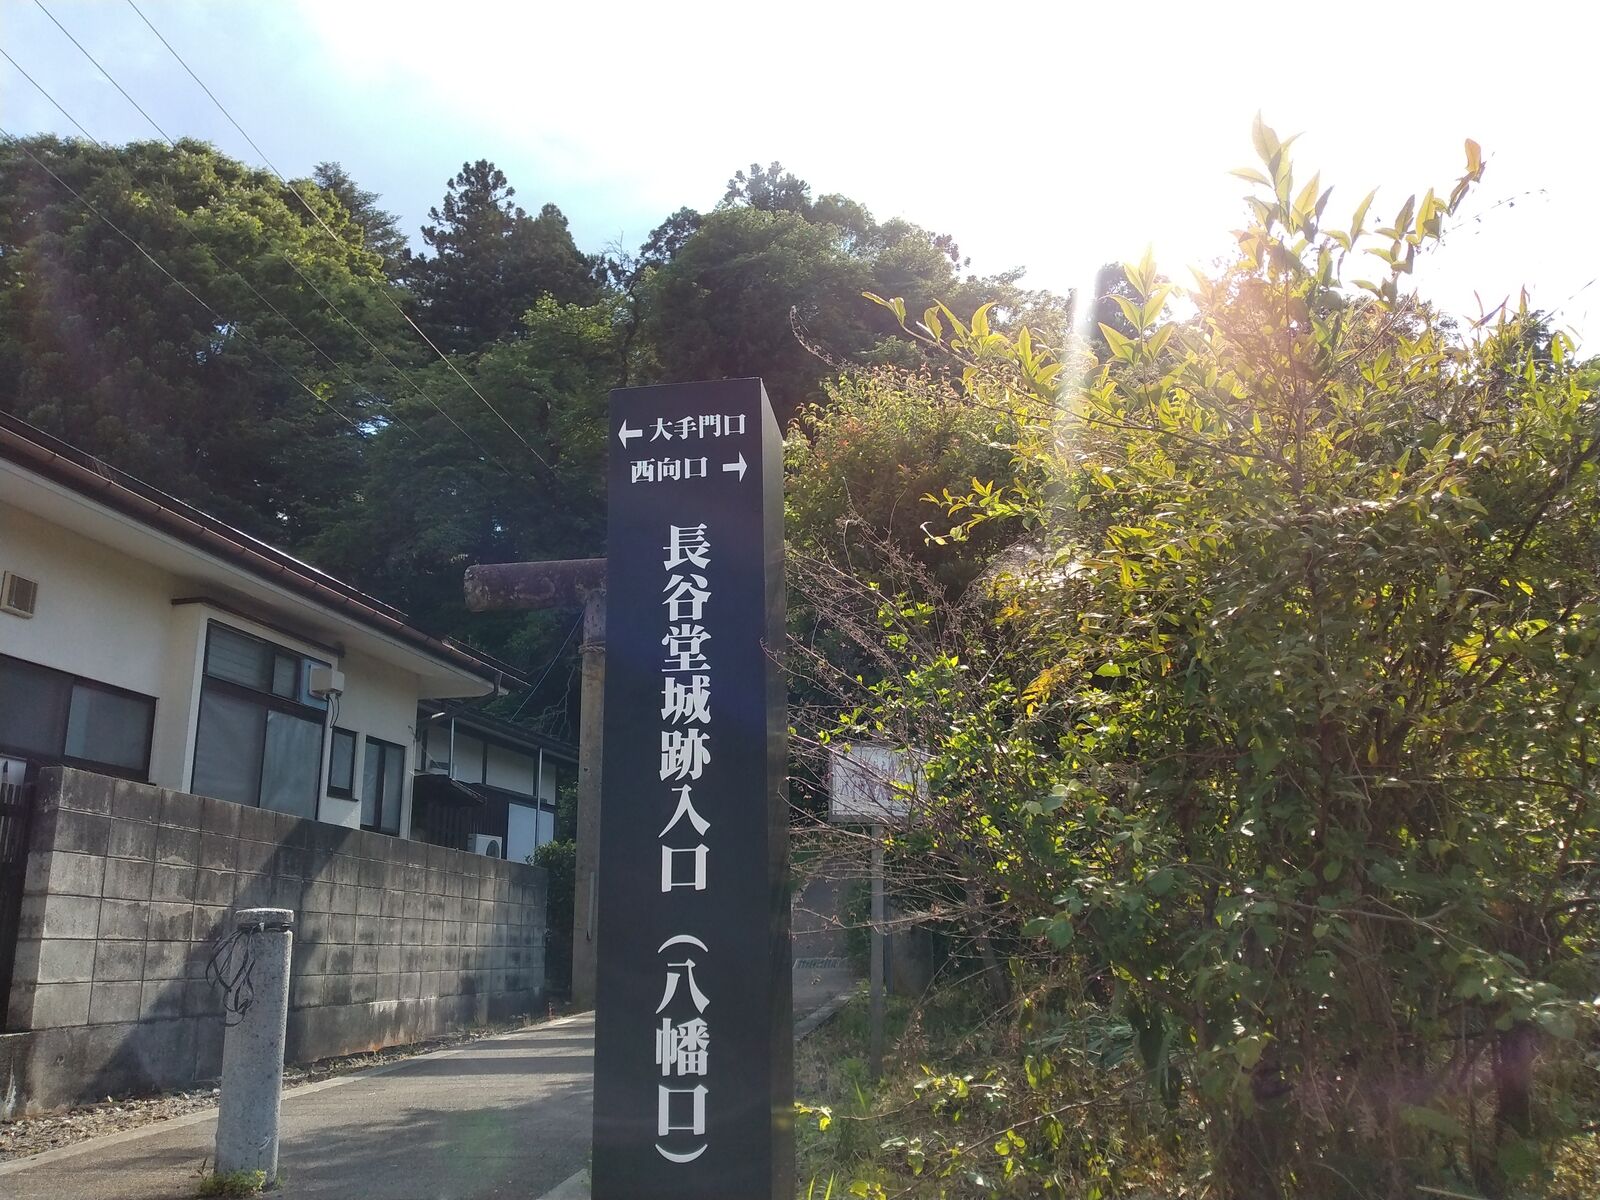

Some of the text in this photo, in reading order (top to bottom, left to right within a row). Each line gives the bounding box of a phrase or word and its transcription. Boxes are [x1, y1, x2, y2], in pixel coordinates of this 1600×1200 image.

[649, 413, 747, 442] 大手門口
[629, 456, 709, 484] 西向口
